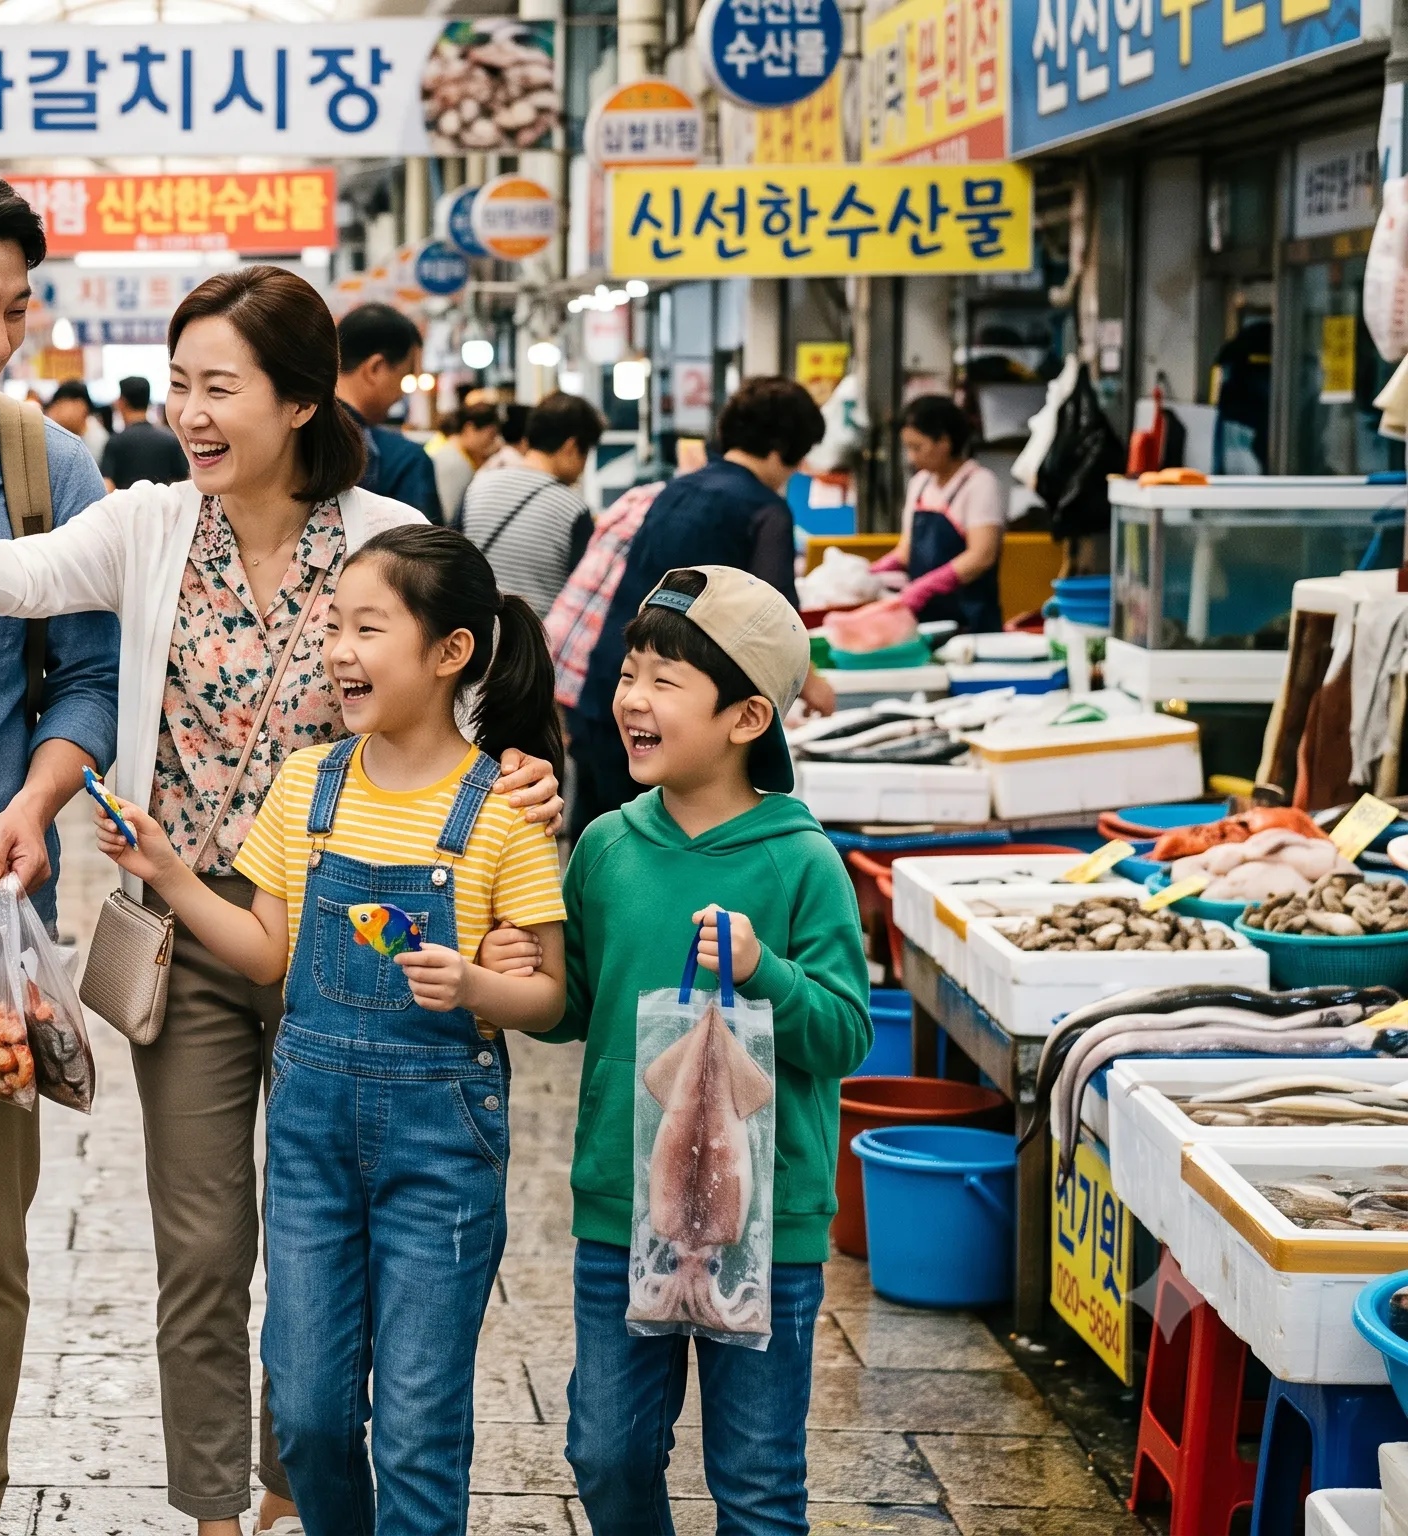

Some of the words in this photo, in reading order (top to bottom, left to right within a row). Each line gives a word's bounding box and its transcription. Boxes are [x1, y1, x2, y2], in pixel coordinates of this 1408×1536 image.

[723, 29, 827, 77] 수산물
[97, 176, 328, 235] 신선한수산물
[629, 178, 1013, 260] 신선한수산물
